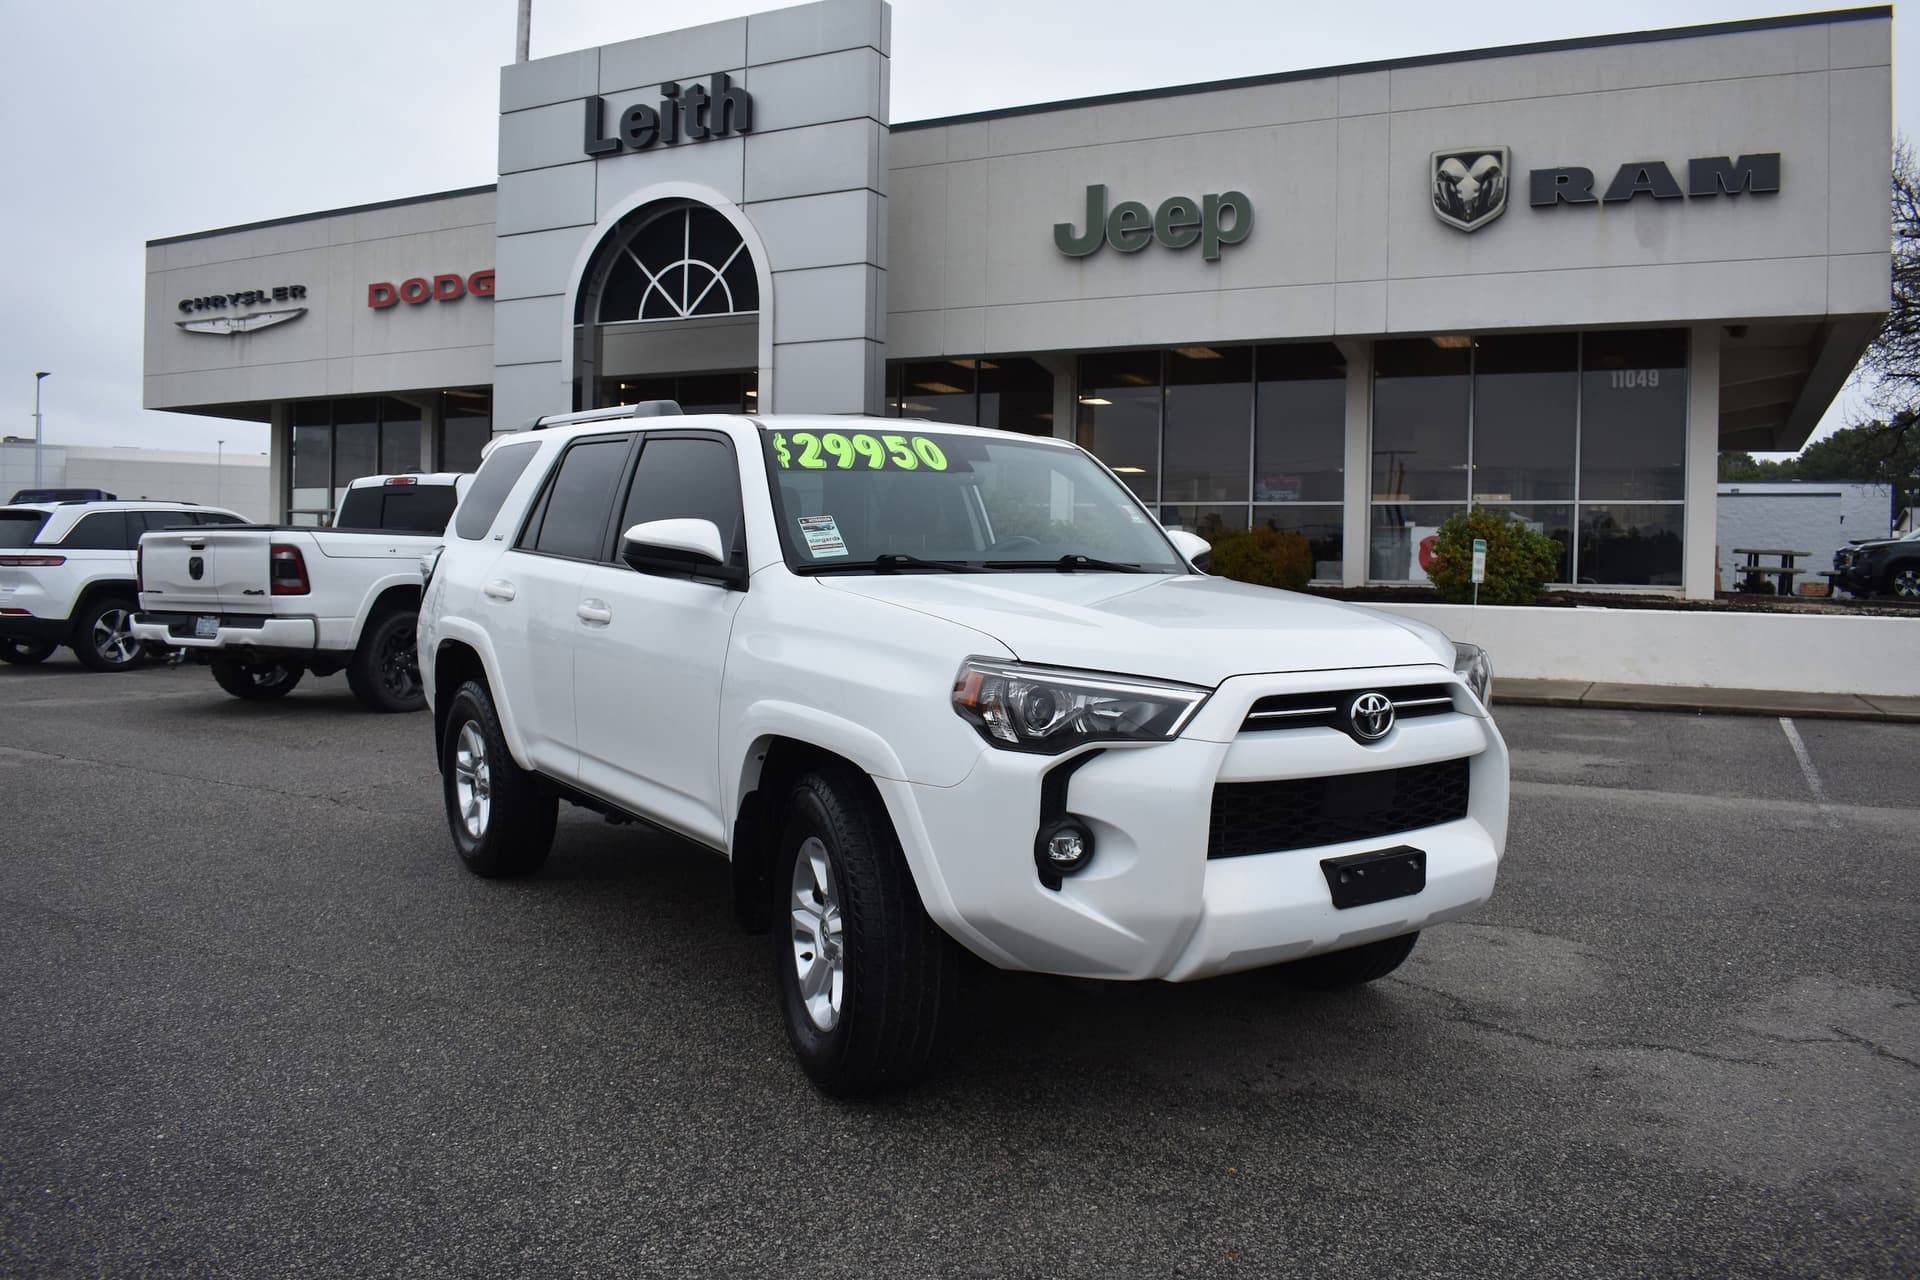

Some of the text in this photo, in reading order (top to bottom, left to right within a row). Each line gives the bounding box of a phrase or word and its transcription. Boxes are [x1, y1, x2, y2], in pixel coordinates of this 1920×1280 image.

[584, 72, 752, 156] Leith
[1530, 153, 1780, 207] RAM
[1054, 184, 1254, 261] Jeep
[178, 285, 307, 313] CHRYSLER
[1611, 369, 1659, 388] 11049
[773, 432, 947, 471] $29950
